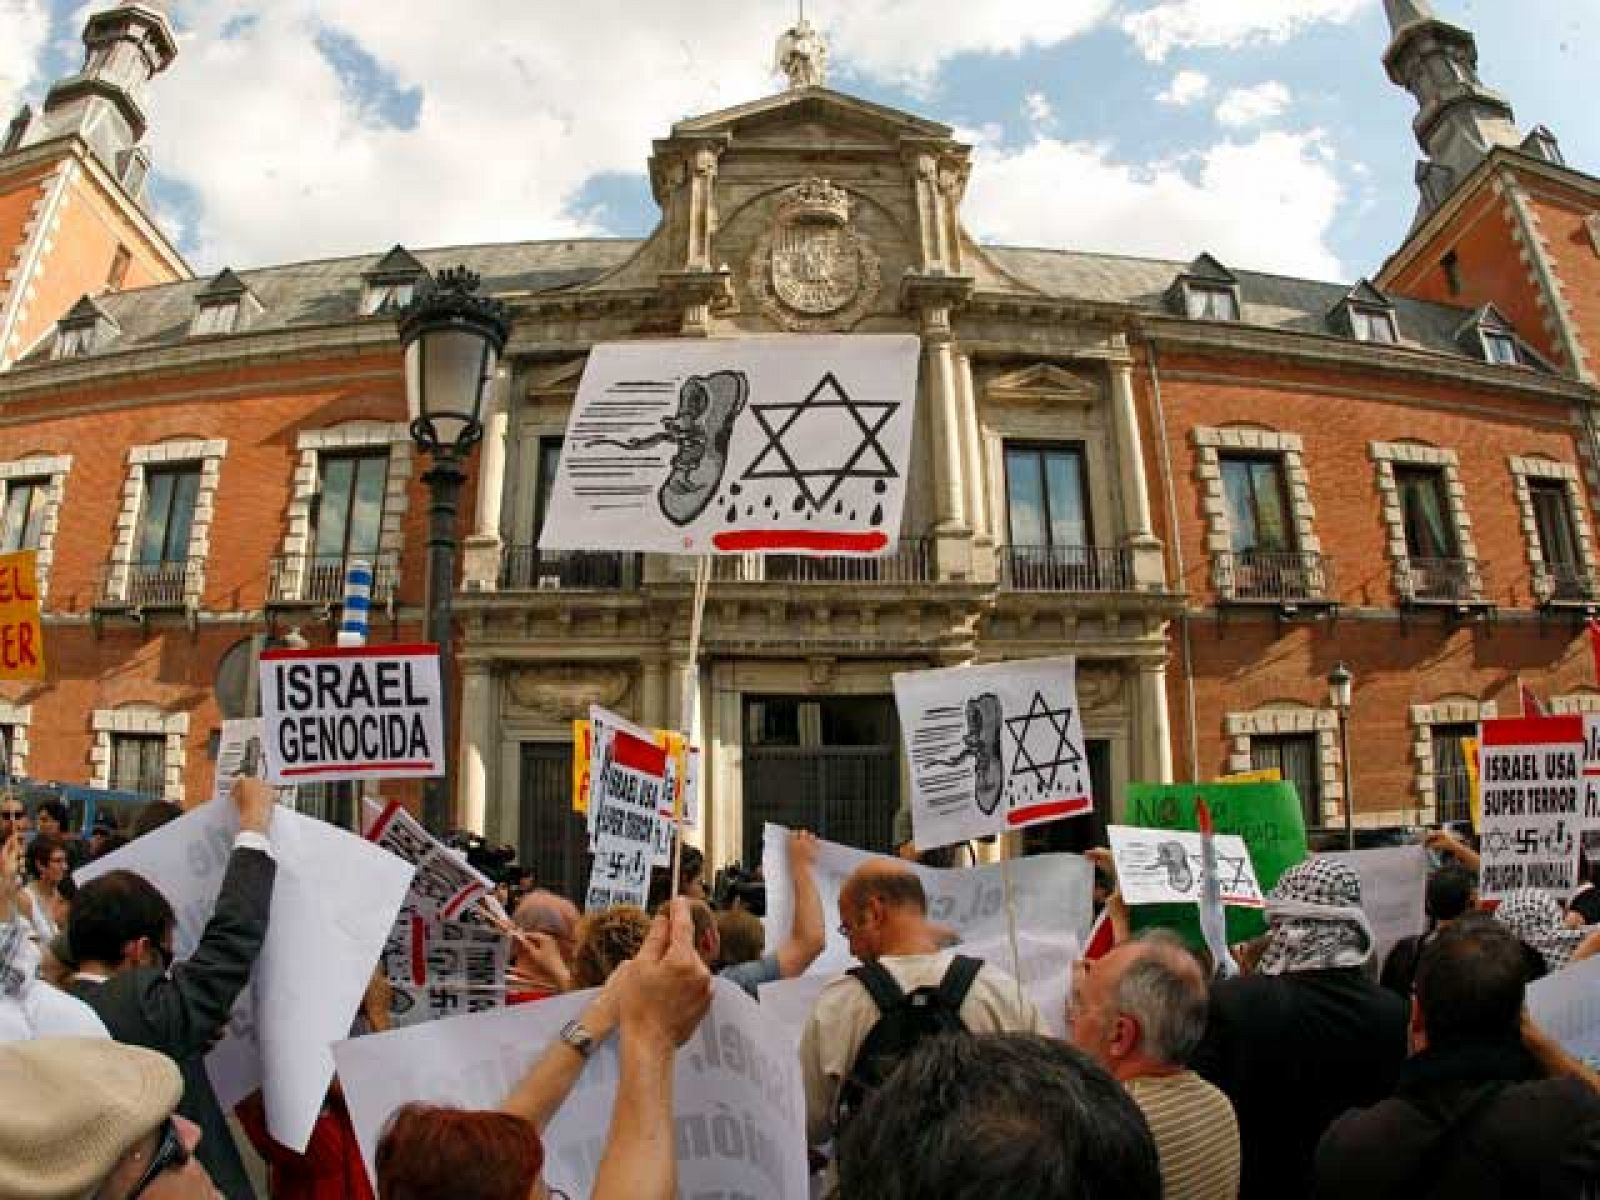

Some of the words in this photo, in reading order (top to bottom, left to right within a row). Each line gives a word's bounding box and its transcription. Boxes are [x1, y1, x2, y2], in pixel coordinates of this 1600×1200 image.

[276, 661, 430, 712] ISRAEL
[279, 713, 430, 763] GENOCIDA
[1484, 755, 1538, 781] ISRAEL
[1545, 752, 1576, 780] USA
